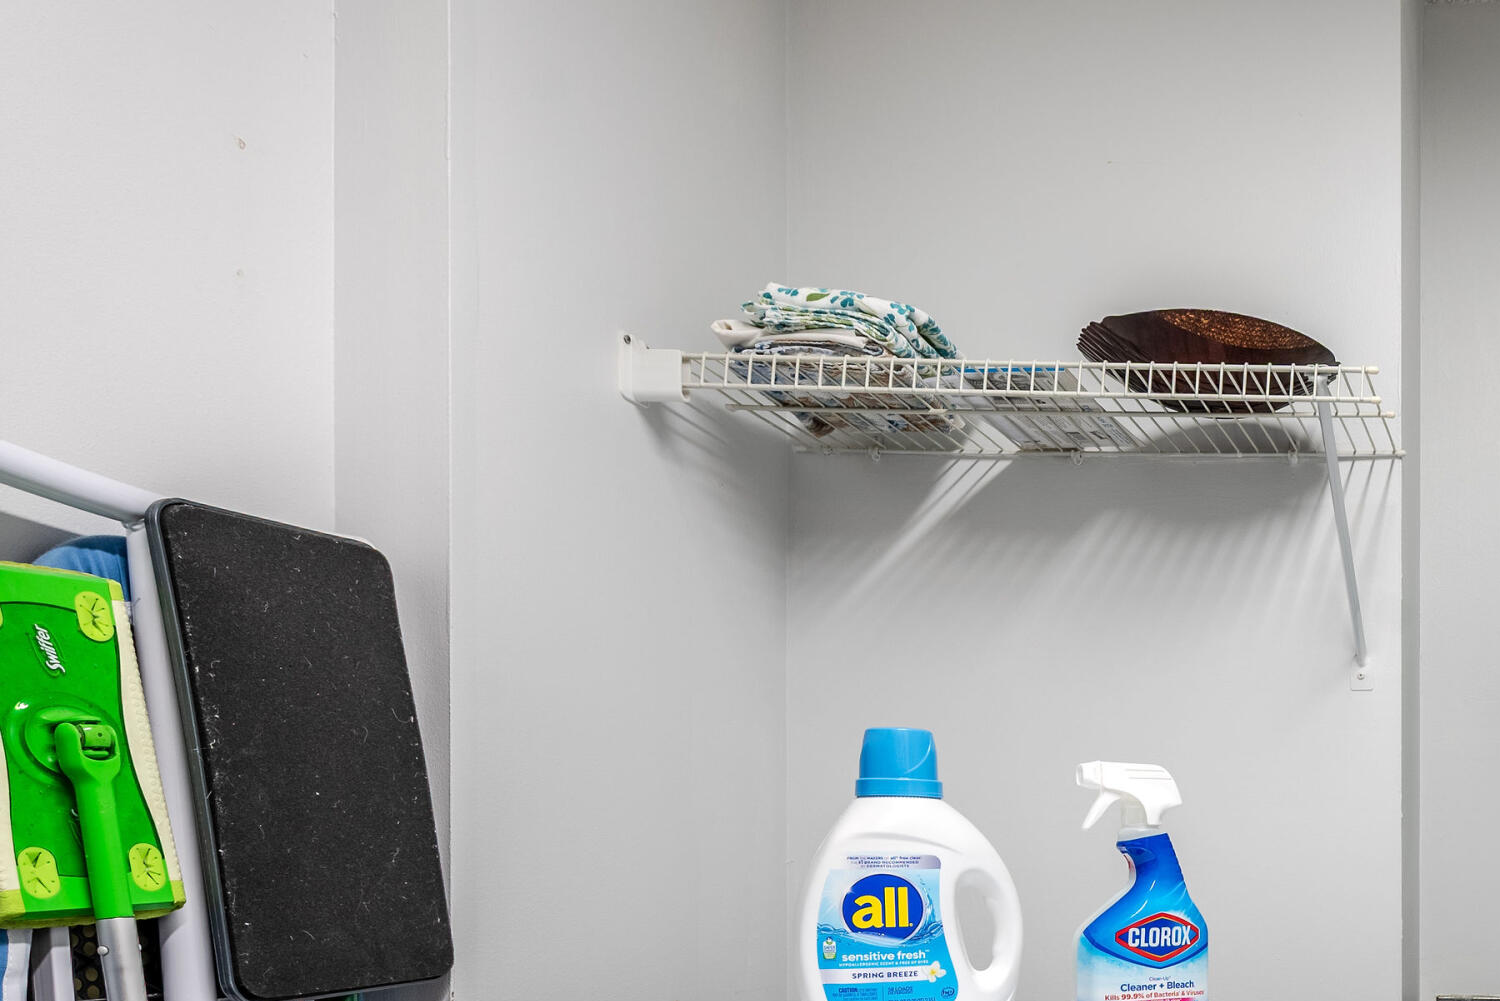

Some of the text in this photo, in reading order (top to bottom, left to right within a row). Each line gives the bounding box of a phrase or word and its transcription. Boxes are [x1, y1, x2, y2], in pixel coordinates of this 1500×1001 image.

[34, 623, 66, 673] Swiffer
[852, 887, 910, 929] all
[1128, 926, 1191, 947] CLOROX
[842, 950, 926, 962] sensitive fresh
[1120, 983, 1157, 992] Cleaner
[1167, 980, 1194, 989] Bleach
